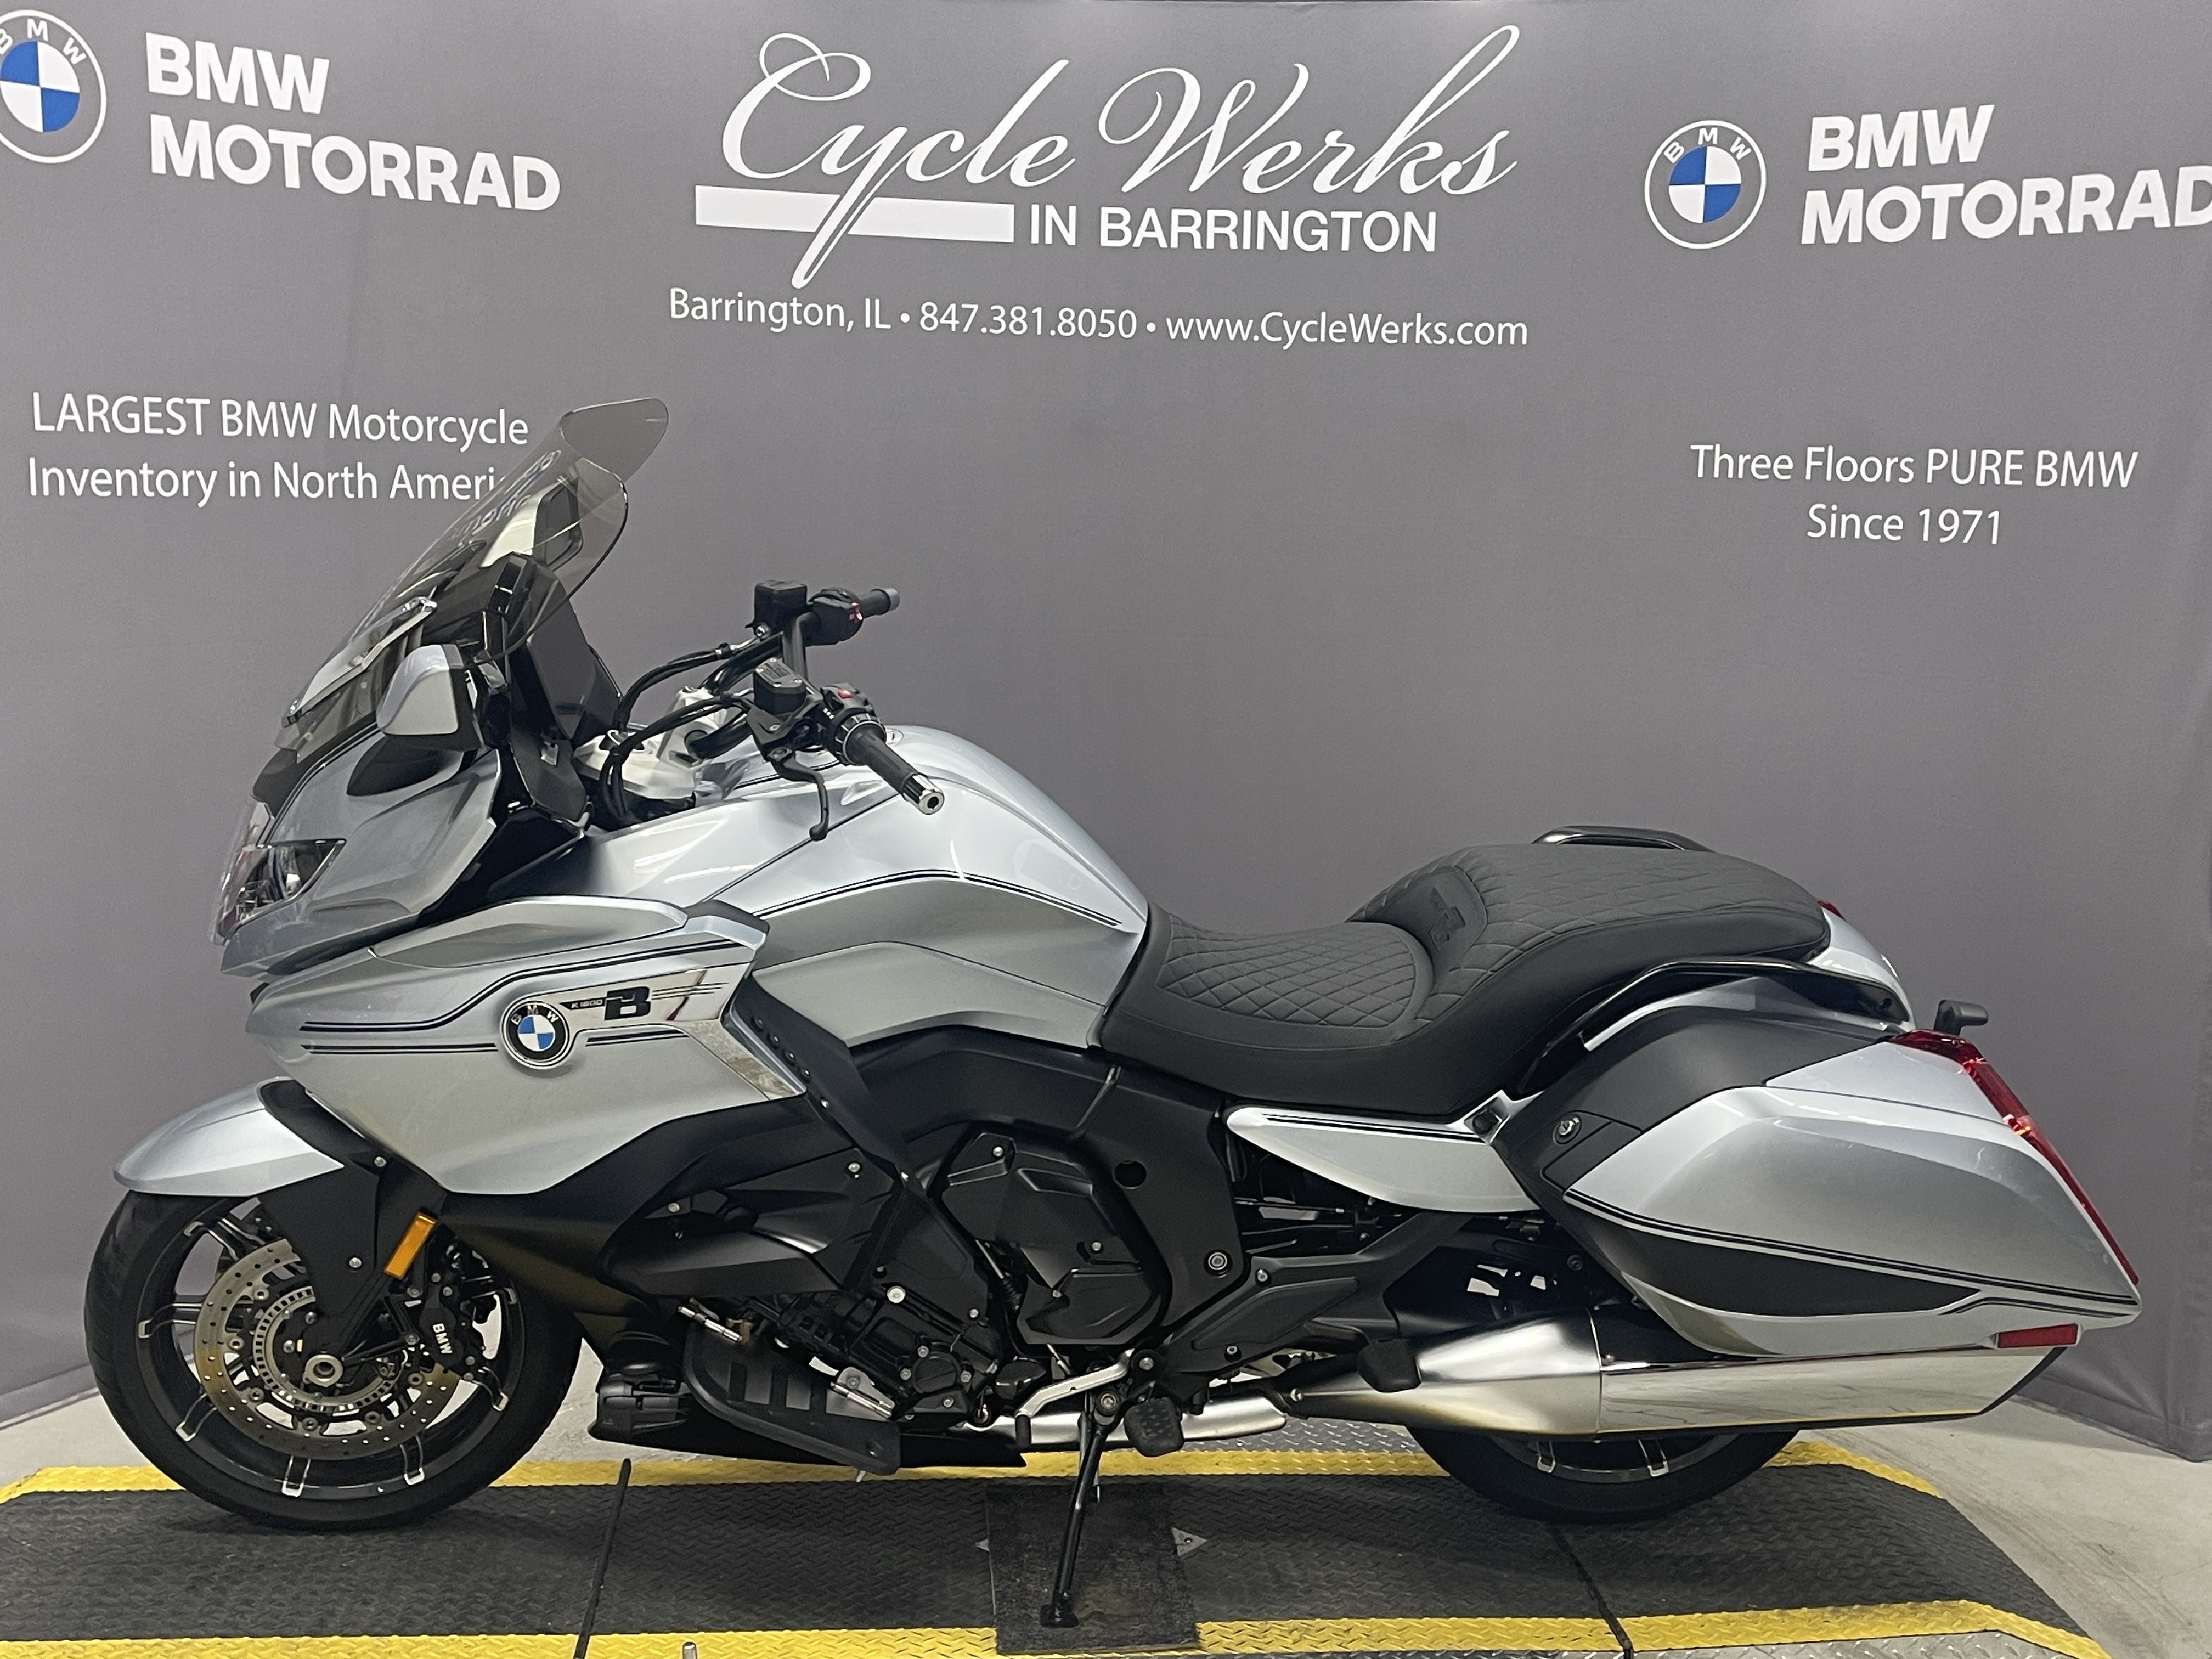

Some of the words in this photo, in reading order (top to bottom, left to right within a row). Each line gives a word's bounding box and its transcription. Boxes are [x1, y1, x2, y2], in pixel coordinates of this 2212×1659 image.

[0, 19, 87, 65] BMW
[145, 32, 330, 114] BMW
[150, 114, 560, 211] MOTORRAD
[721, 32, 1076, 289] Cycle
[1098, 25, 1520, 195] Werks
[1663, 127, 1752, 163] BMW
[1808, 104, 1995, 171] BMW
[1031, 204, 1077, 246] IN
[1099, 207, 1436, 252] BARRINGTON
[1801, 165, 2212, 245] MOTORRAD
[670, 288, 854, 332] Barrington,
[865, 298, 891, 329] IL
[919, 302, 1137, 338] 847.381.8050
[1166, 311, 1528, 351] www.CycleWerks.com
[33, 392, 211, 435] LARGEST
[221, 399, 317, 438] BMW
[329, 403, 528, 453] Motorcycle
[29, 457, 217, 508] Inventory
[228, 461, 261, 498] in
[274, 461, 377, 499] North
[390, 465, 505, 500] Ameri
[1690, 443, 1793, 480] Three
[1805, 445, 1914, 483] Floors
[1927, 448, 2024, 486] PURE
[2036, 450, 2138, 488] BMW
[1807, 503, 1904, 541] Since
[1919, 508, 2000, 544] 1971
[511, 1004, 559, 1025] BMW
[432, 1323, 453, 1354] BMW
